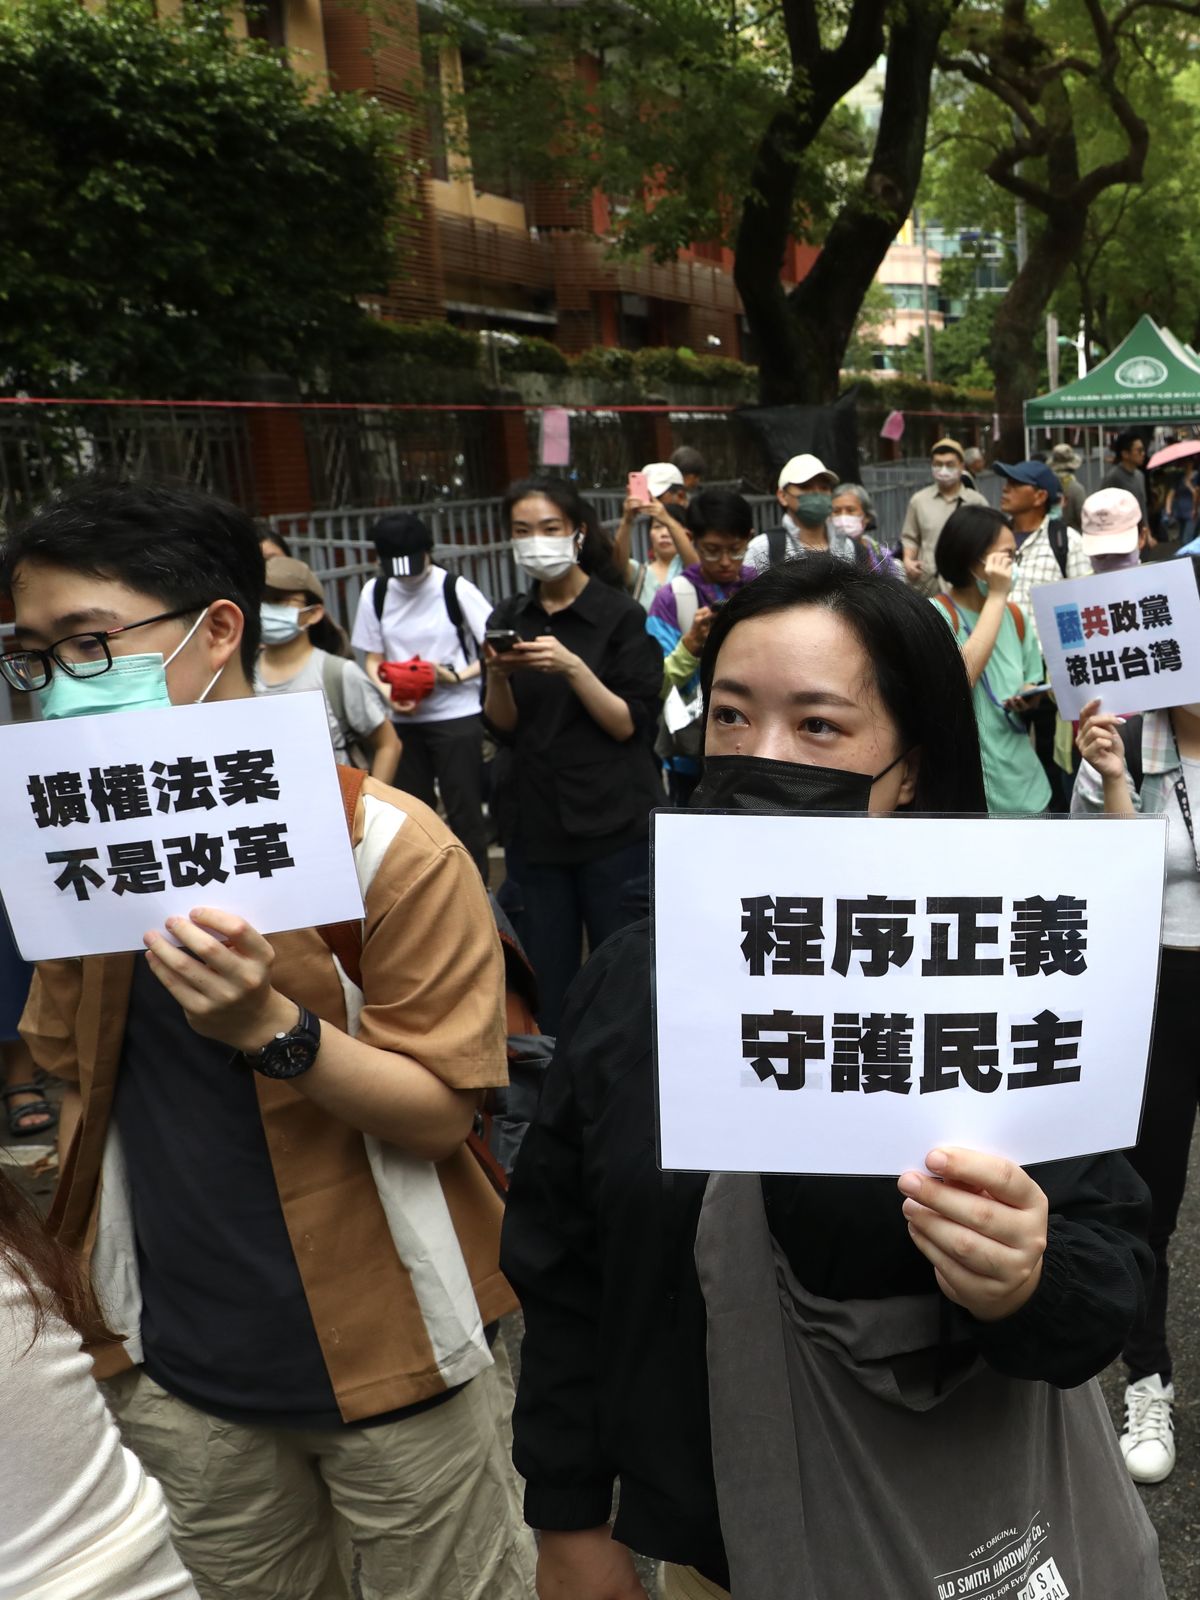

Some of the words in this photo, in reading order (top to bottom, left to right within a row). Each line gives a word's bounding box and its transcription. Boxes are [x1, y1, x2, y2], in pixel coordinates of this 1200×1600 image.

[1065, 638, 1183, 687] 滾出台灣
[27, 749, 280, 828] 擴權法案
[45, 822, 295, 901] 不是改革
[740, 894, 1088, 977] 程序正義
[740, 1009, 1083, 1095] 守護民主
[968, 1544, 986, 1559] THE
[986, 1527, 1018, 1549] ORIGINAL
[937, 1581, 956, 1600] OLD
[957, 1567, 991, 1594] SMITH
[997, 1583, 1011, 1597] FOR
